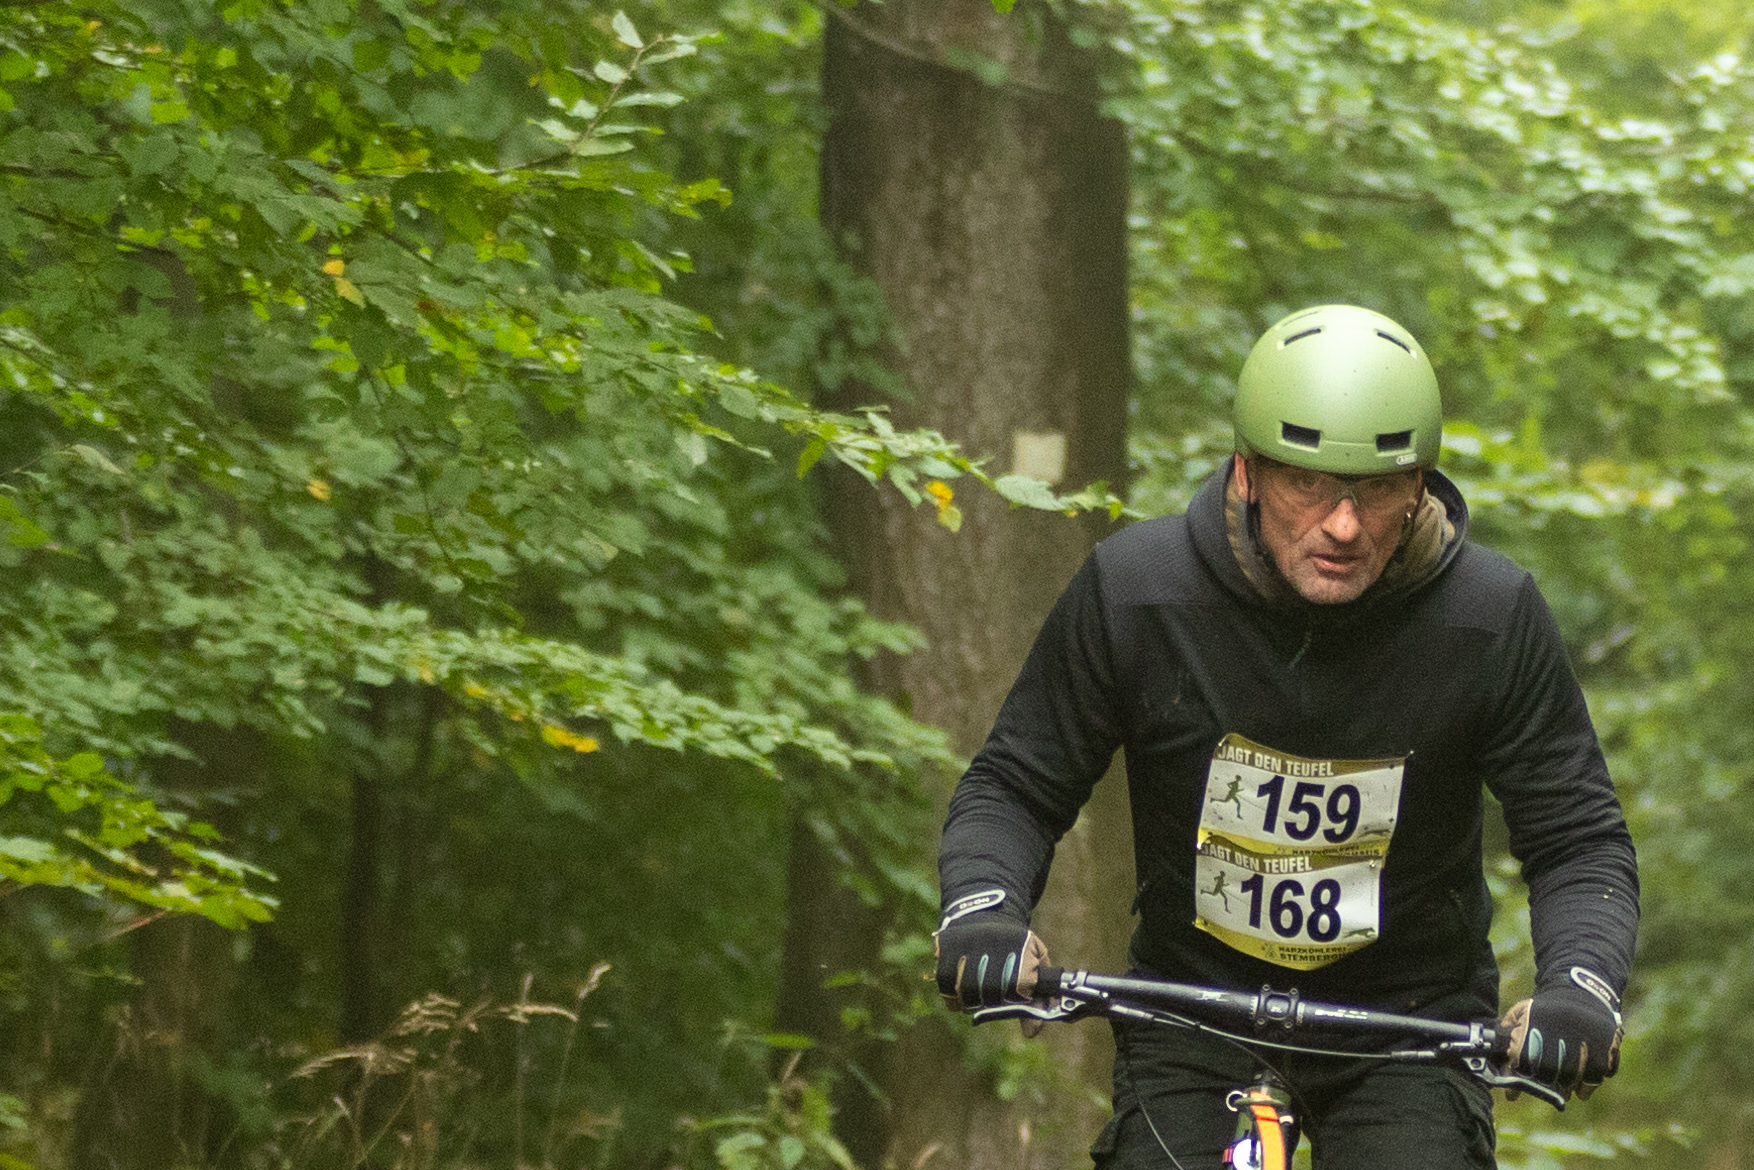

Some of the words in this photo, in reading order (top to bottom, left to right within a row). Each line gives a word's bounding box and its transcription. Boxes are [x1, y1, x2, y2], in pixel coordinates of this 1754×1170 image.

[1217, 744, 1251, 765] JAGT
[1254, 752, 1282, 773] DEN
[1286, 760, 1335, 778] TEUFEL
[1256, 774, 1361, 844] 159
[1234, 851, 1260, 872] DEN
[1263, 856, 1313, 873] TEUFEL
[1240, 873, 1342, 943] 168
